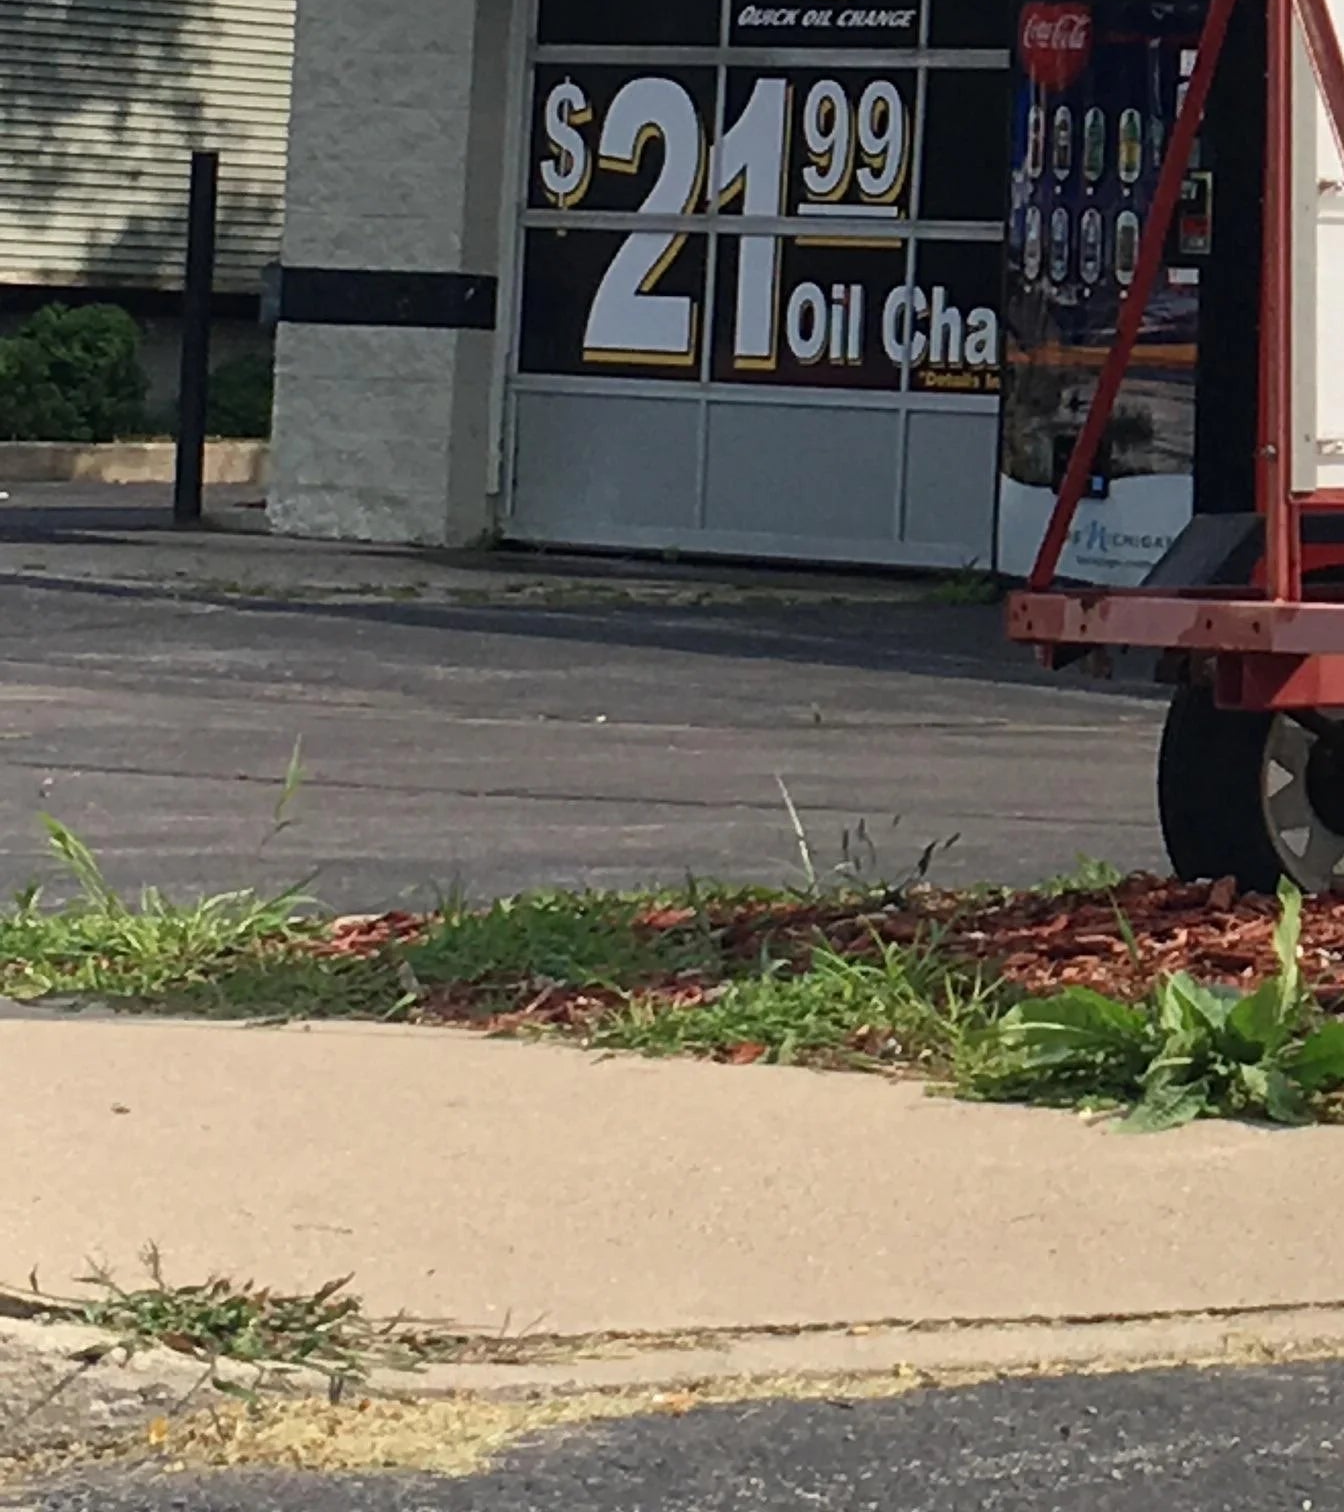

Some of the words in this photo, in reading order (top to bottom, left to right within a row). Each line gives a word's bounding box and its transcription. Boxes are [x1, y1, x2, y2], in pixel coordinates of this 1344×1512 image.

[801, 10, 833, 27] OIL
[836, 10, 916, 27] CHANGE
[787, 282, 863, 366] Oil
